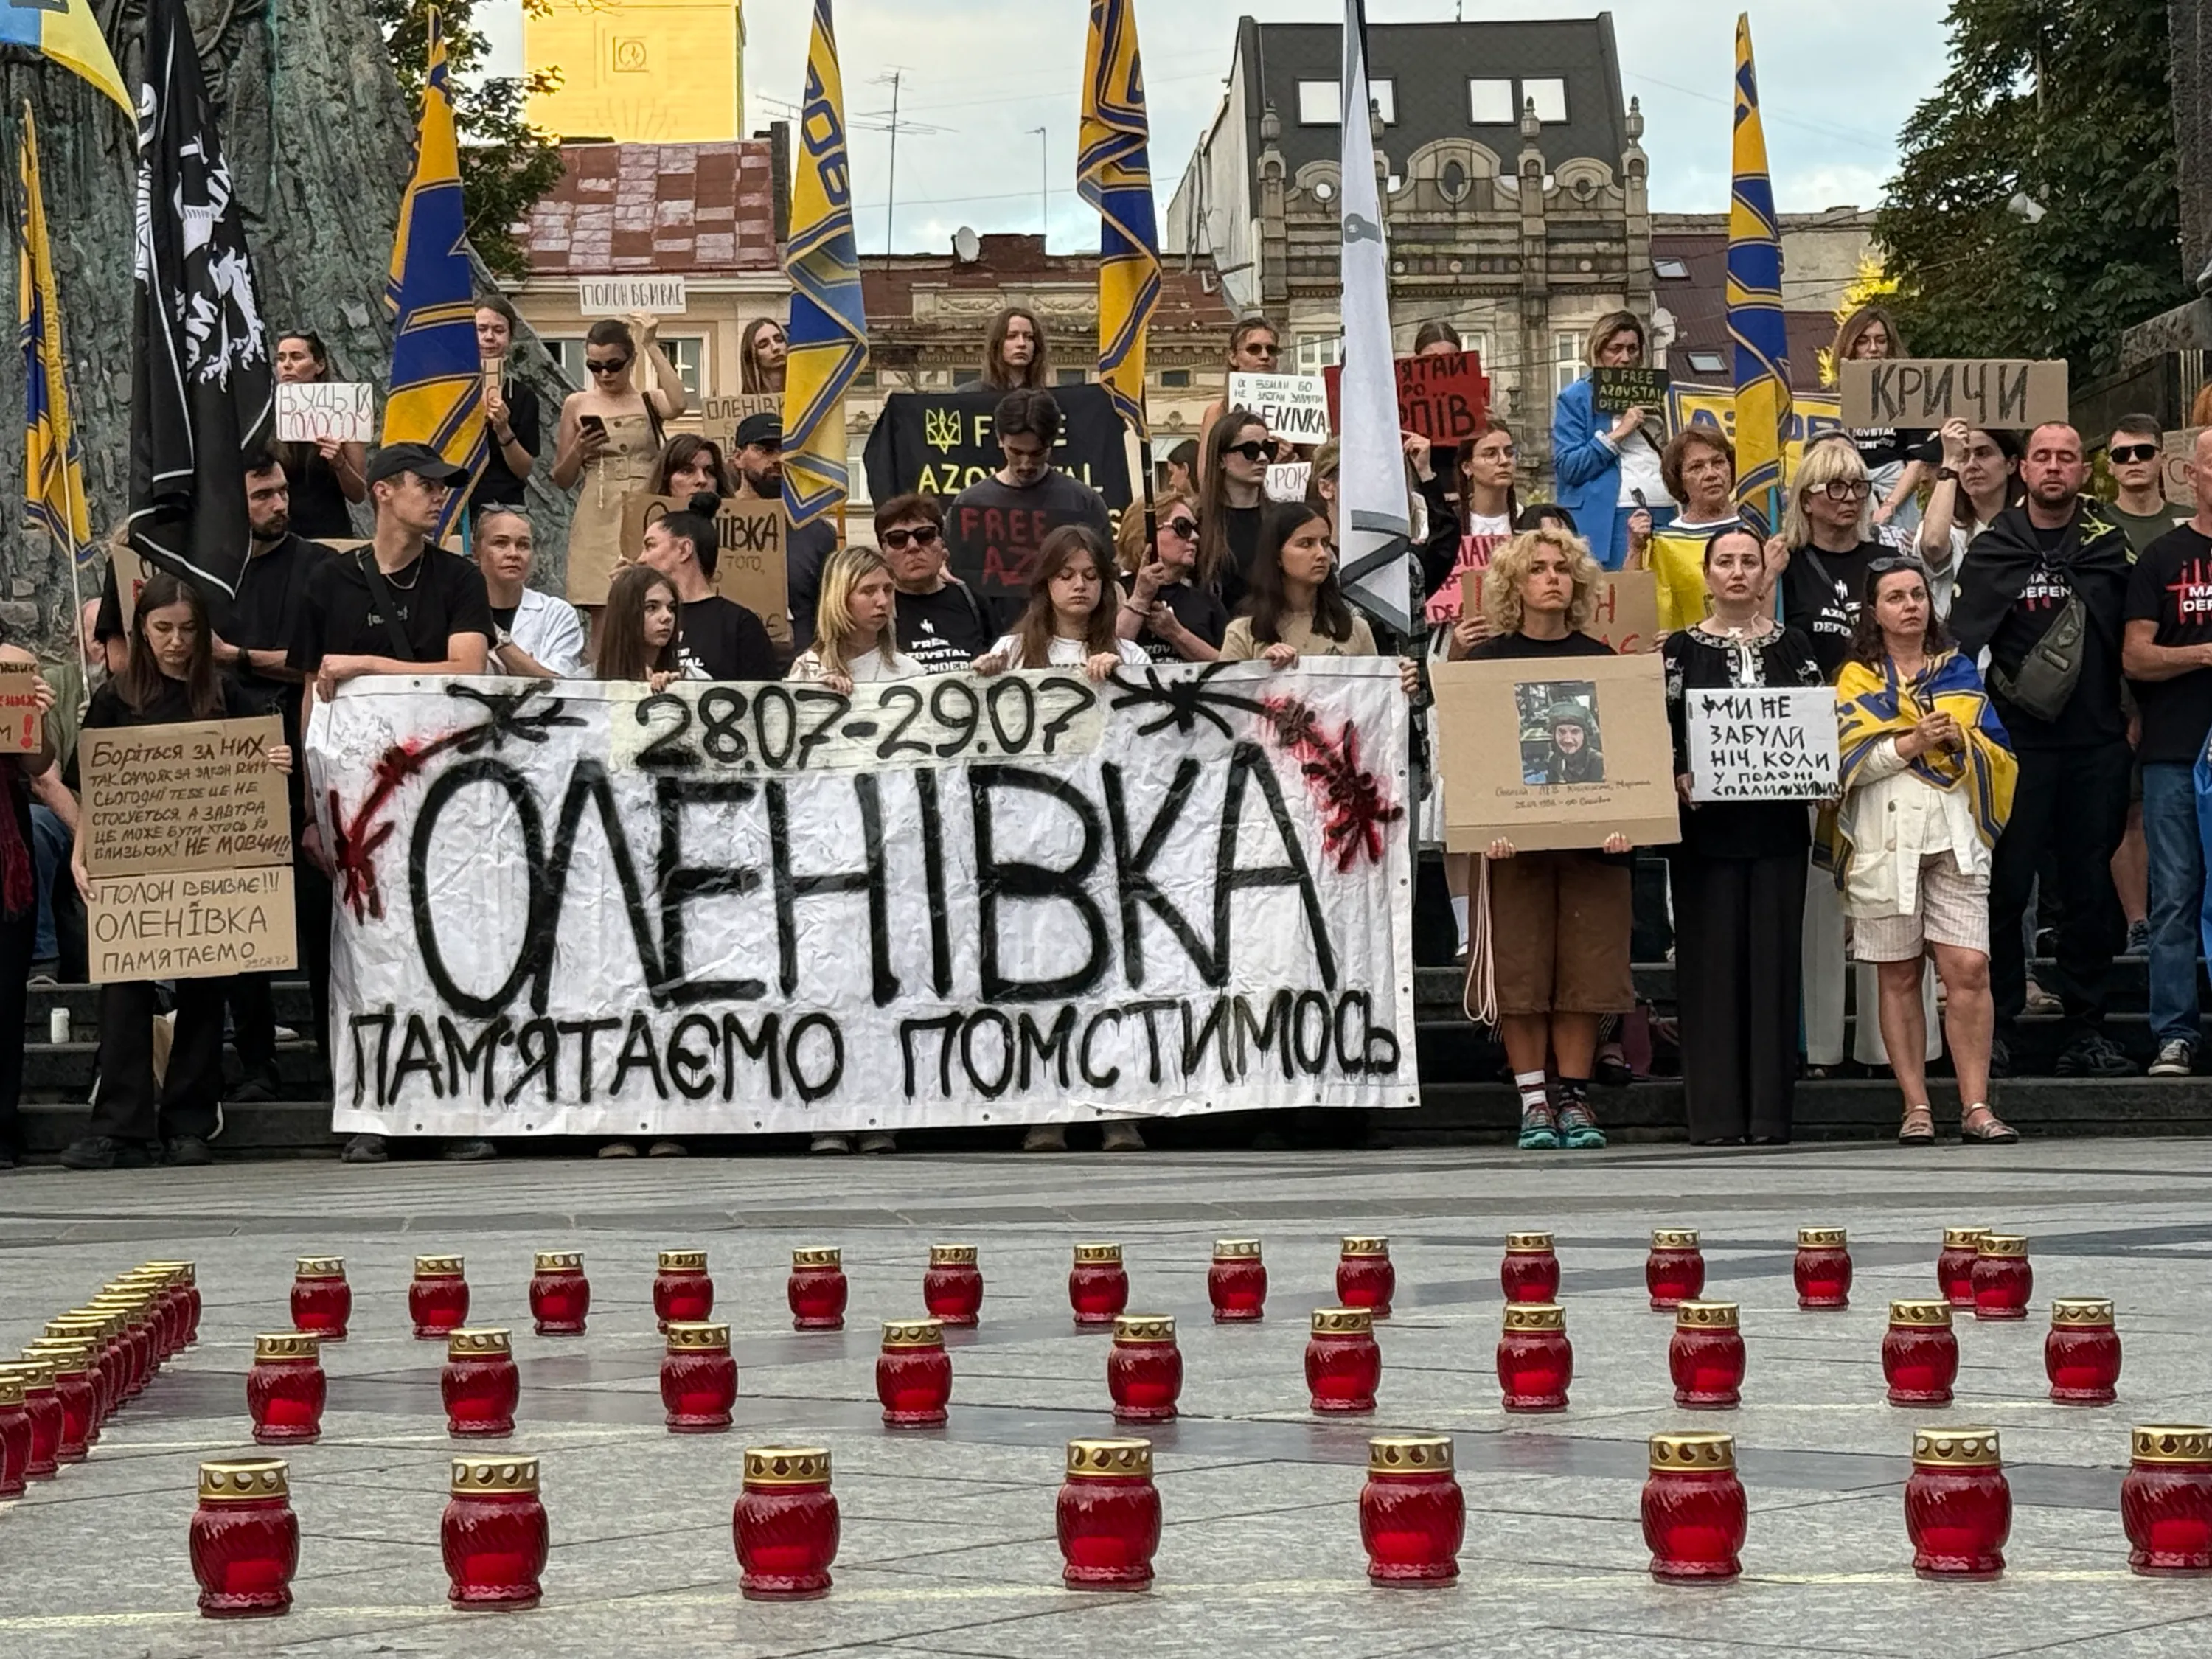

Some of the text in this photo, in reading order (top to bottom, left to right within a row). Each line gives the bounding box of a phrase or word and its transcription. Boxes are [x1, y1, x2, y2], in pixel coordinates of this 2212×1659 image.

[582, 283, 627, 306] ПОЛОН
[1621, 369, 1655, 385] FREE
[1871, 364, 2029, 424] КРИЧИ
[706, 397, 785, 420] ОЛЕНІВК
[974, 414, 1068, 448] FE
[960, 507, 1047, 543] FREE
[905, 648, 971, 660] ZOVSTAL
[1760, 695, 1791, 719] НЕ
[636, 676, 1096, 771] 28.07-29.07
[192, 744, 215, 761] ЗА
[221, 734, 266, 759] НИХ
[1709, 724, 1805, 750] ЗАБУЛИ
[1763, 751, 1830, 771] КОЛИ
[209, 785, 230, 797] ЦЕ
[234, 781, 259, 795] НЕ
[1714, 771, 1813, 785] У ПОЛОНІ
[188, 805, 198, 821] А
[202, 801, 265, 821] ЗАВТРА
[94, 831, 116, 845] ЦЕ
[184, 836, 212, 857] НЕ
[409, 742, 1336, 1018] ОЛЕНІВКА
[100, 879, 175, 905] ПОЛОН
[349, 989, 1402, 1107] ПАМ'ЯТАЄМО ПОМСТИМОСЬ
